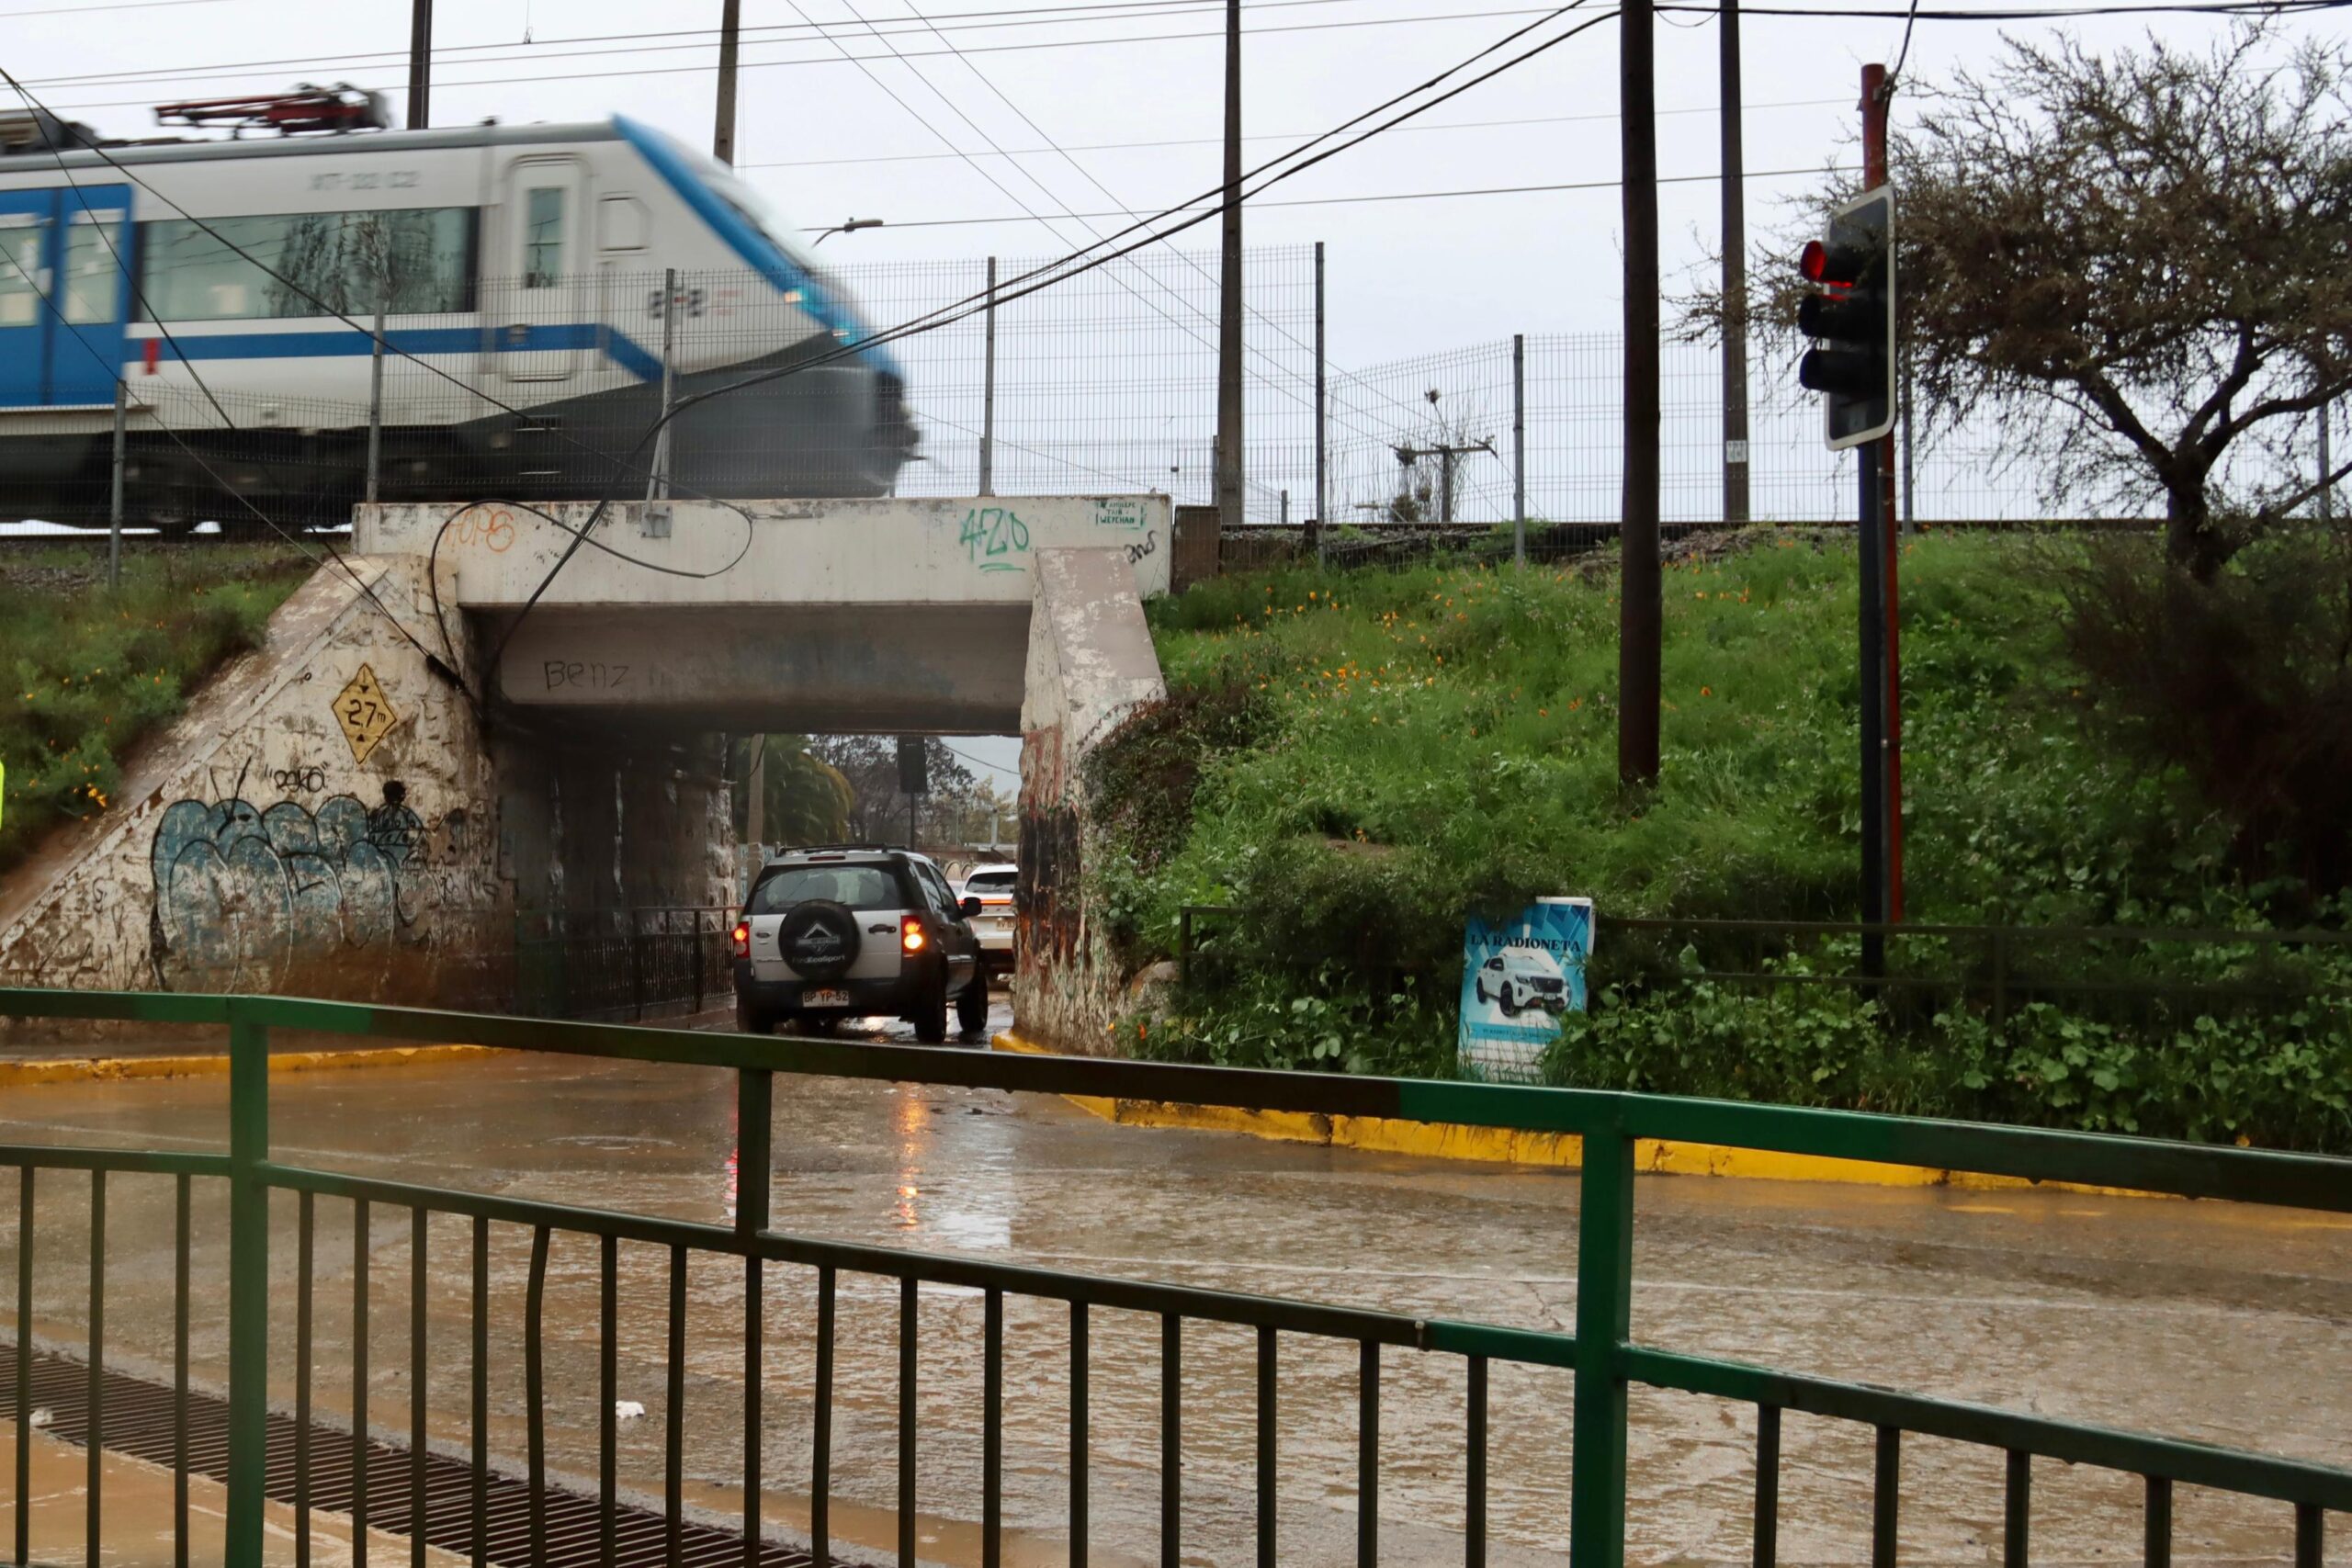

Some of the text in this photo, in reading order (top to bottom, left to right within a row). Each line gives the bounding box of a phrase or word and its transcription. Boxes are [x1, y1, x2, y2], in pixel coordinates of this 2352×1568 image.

[960, 507, 1030, 563] 420
[544, 660, 629, 693] Benz
[1470, 934, 1581, 953] LA RADIONETA
[804, 992, 817, 1003] BP
